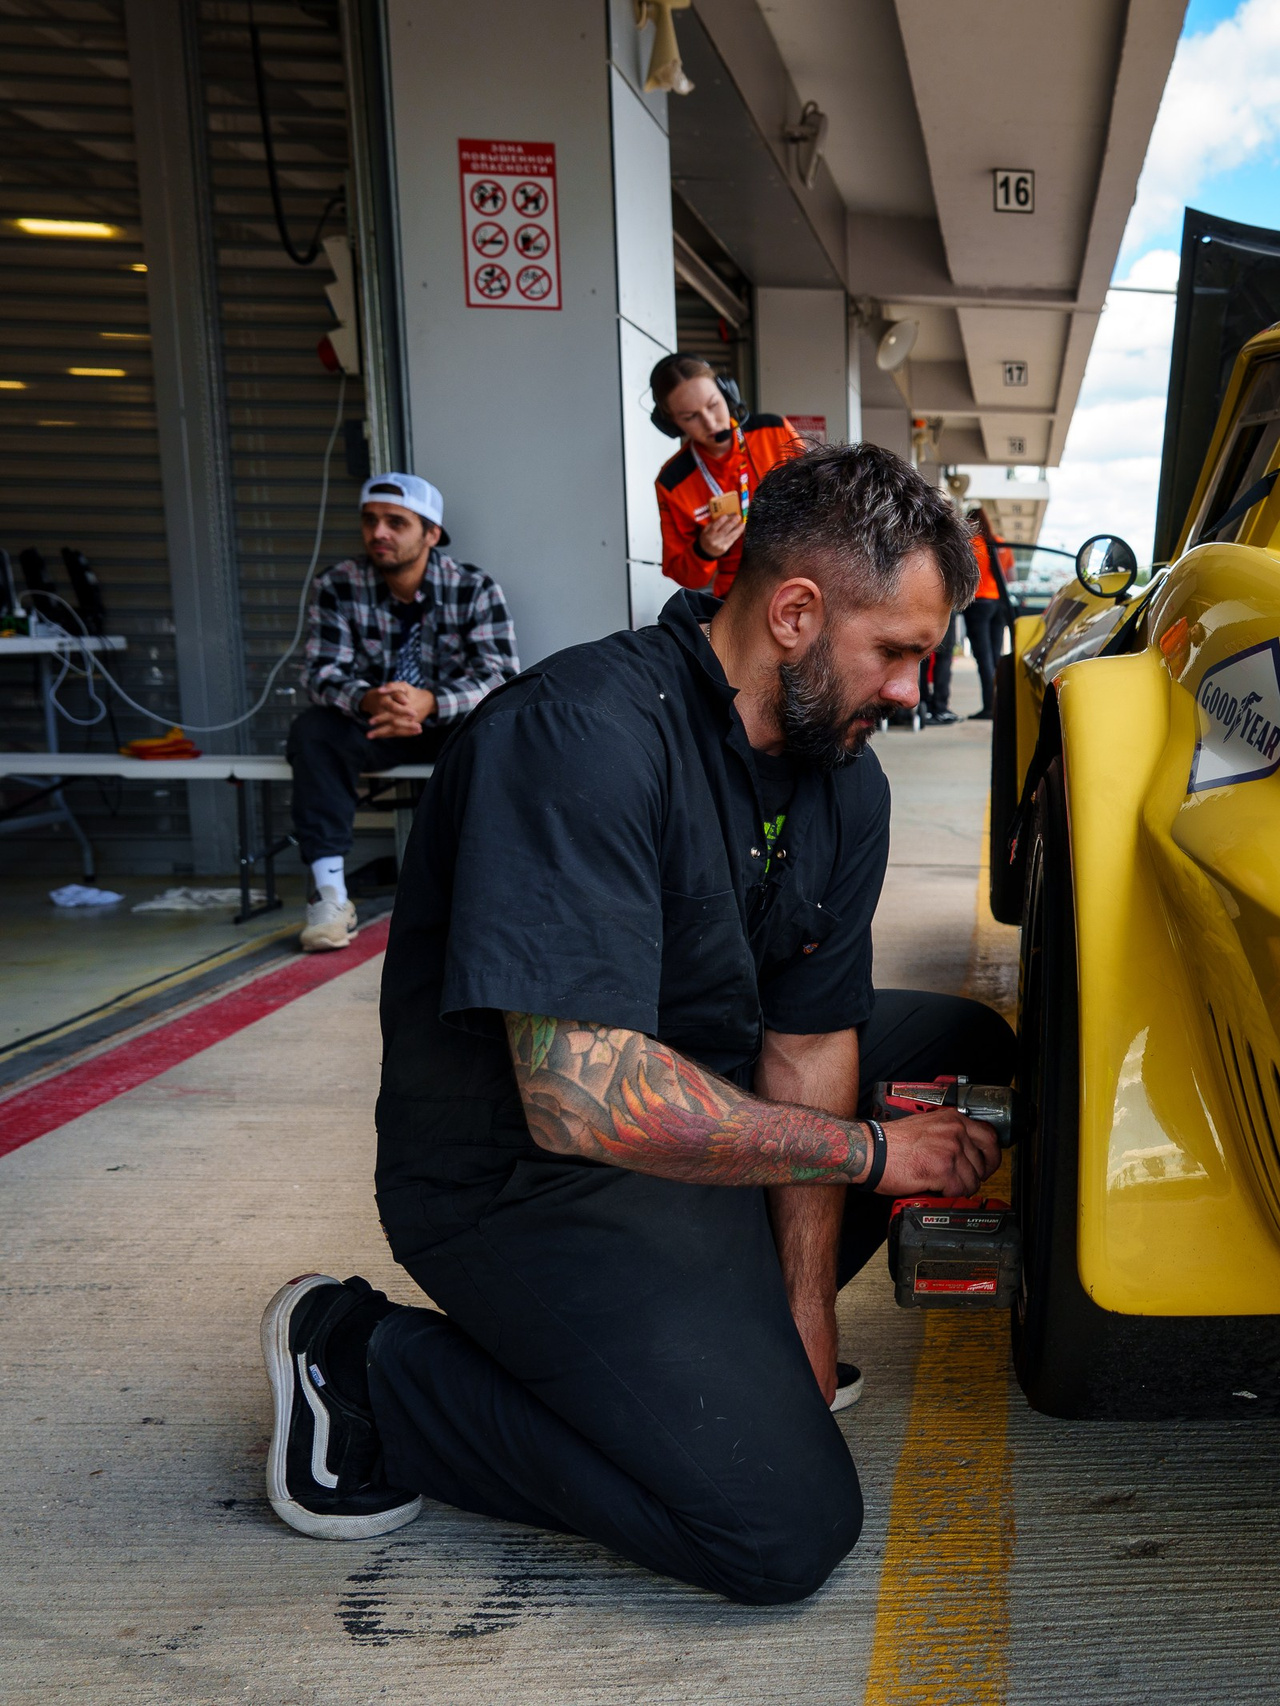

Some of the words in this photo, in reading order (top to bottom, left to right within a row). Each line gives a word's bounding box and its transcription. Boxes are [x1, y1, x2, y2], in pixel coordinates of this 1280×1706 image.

[491, 144, 524, 153] ЗОНА
[462, 151, 553, 164] ПОВЫШЕННОЙ
[471, 162, 548, 173] ОПАСНОСТИ
[999, 176, 1029, 206] 16
[1006, 366, 1024, 383] 17
